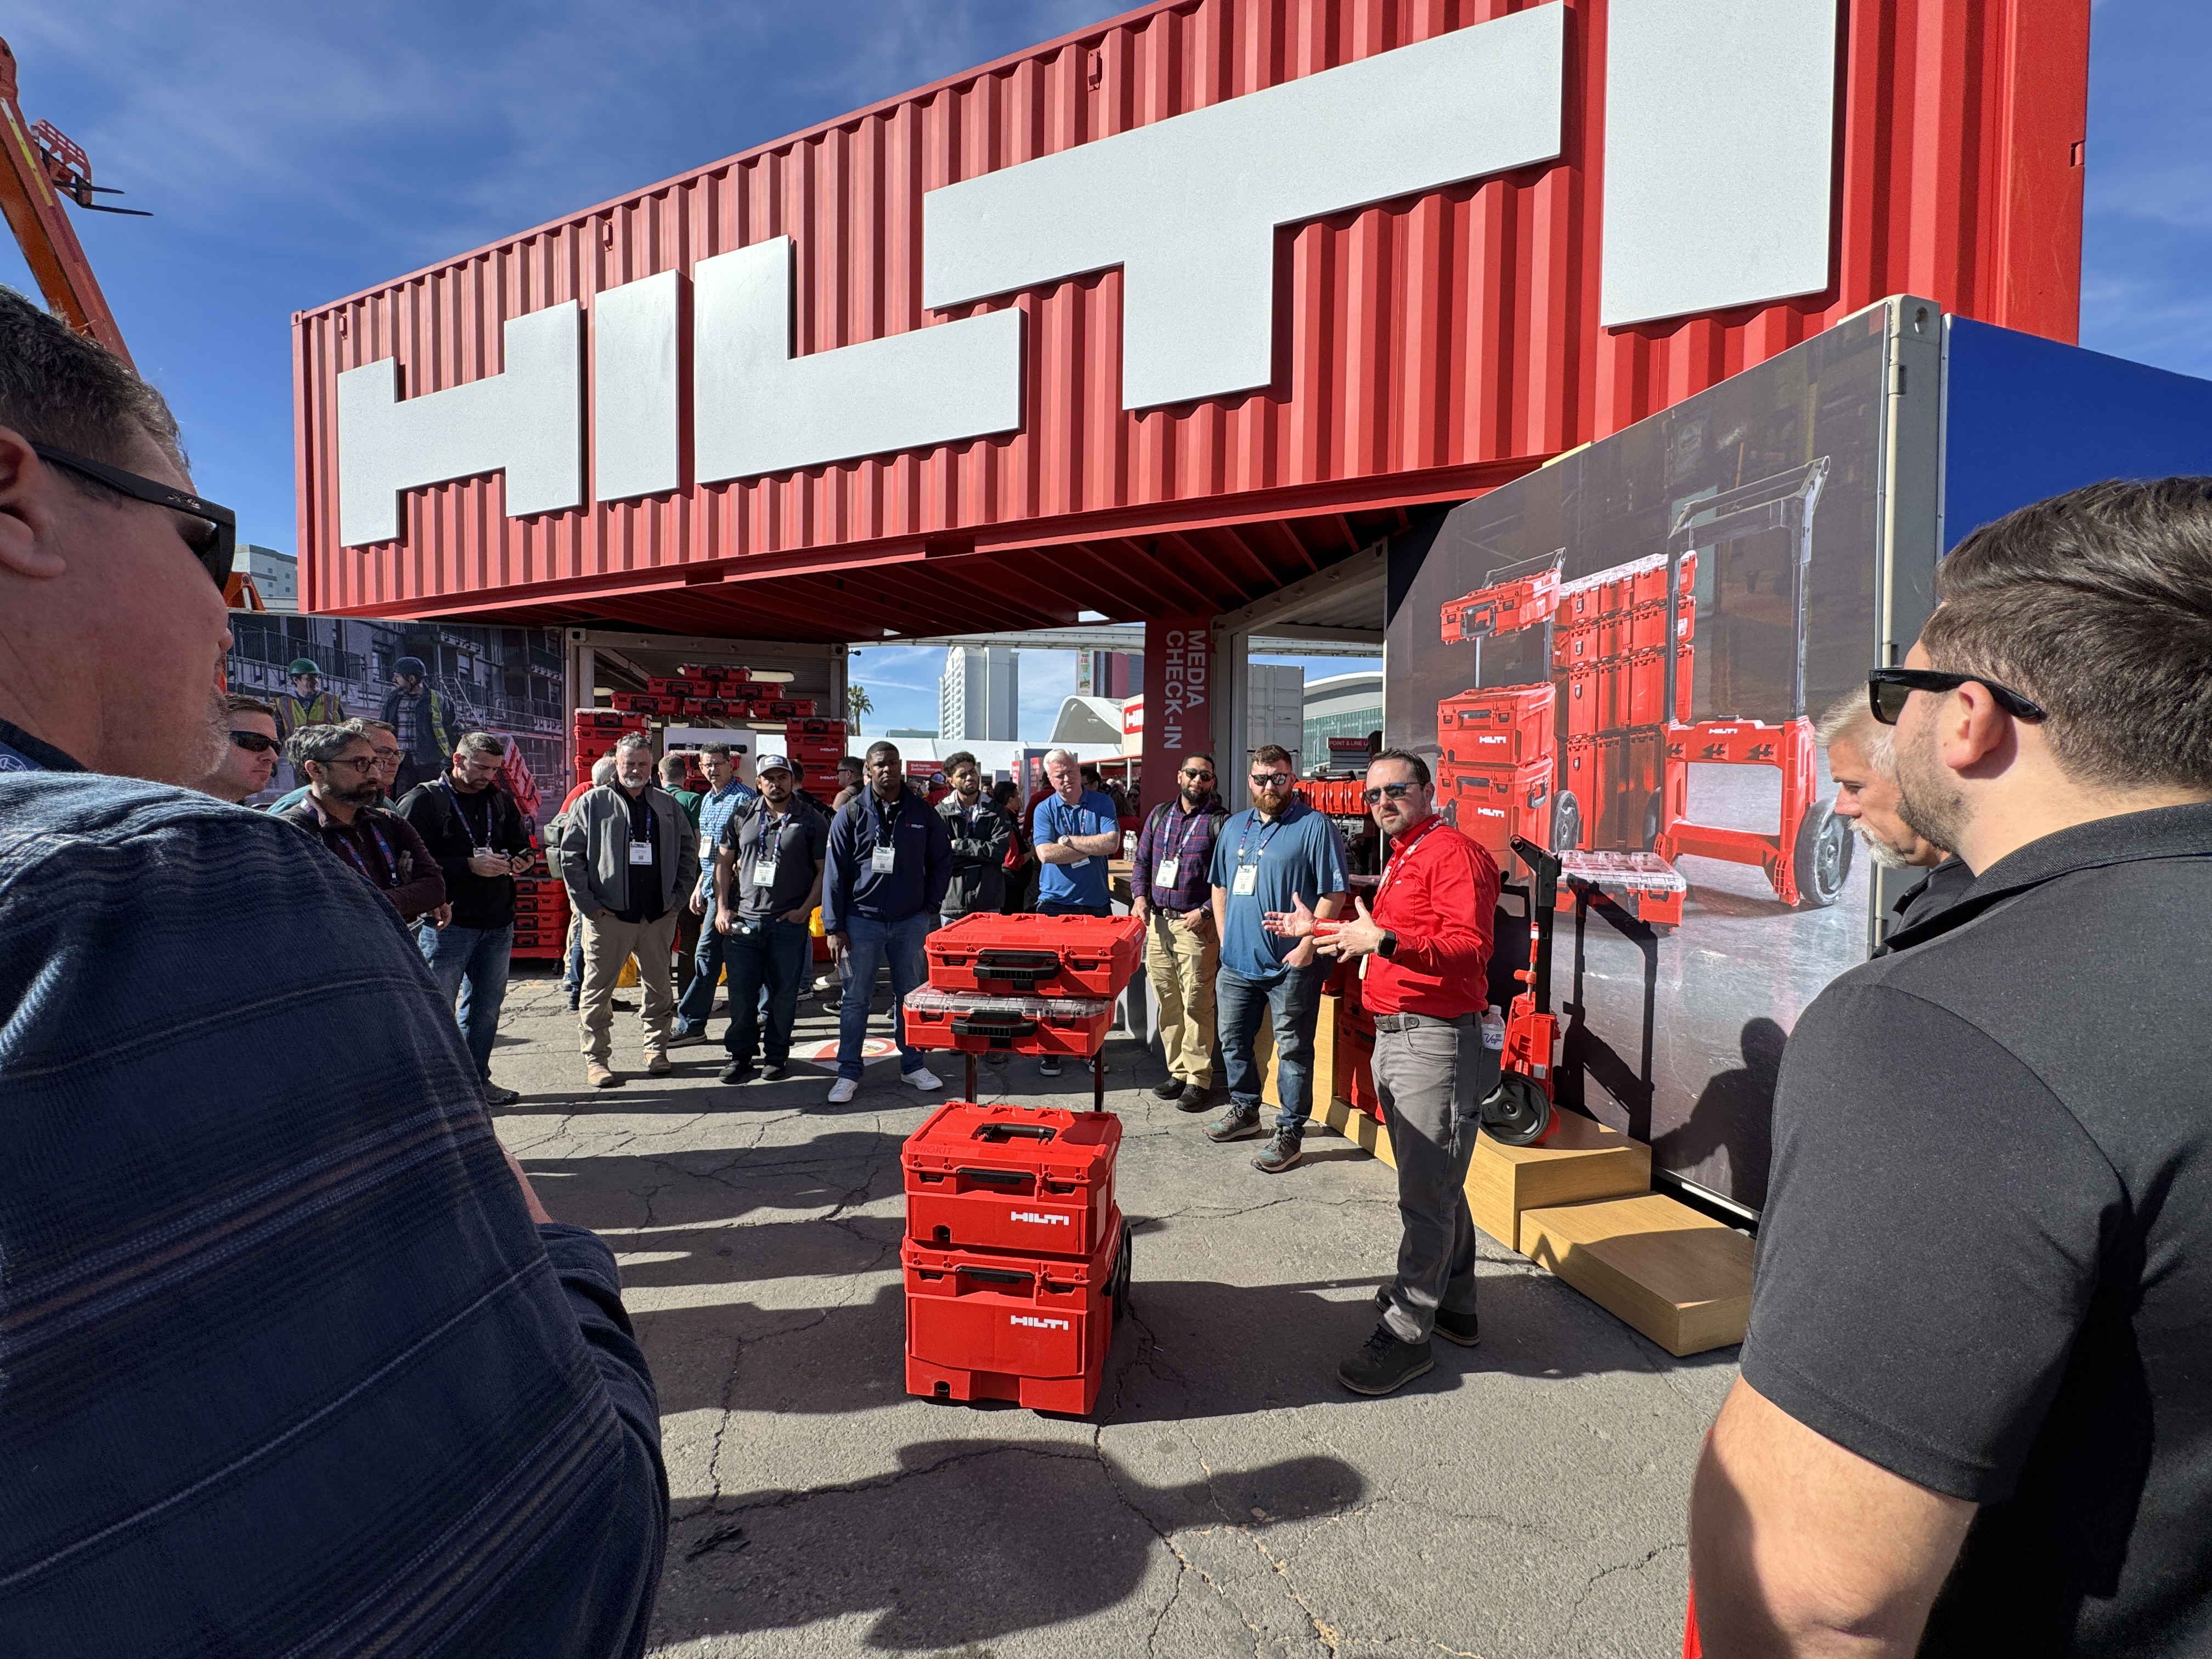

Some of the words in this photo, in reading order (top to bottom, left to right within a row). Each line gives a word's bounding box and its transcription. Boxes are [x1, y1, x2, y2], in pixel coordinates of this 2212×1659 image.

[338, 0, 1836, 547] HILTI
[1186, 630, 1206, 709] MEDIA
[1164, 630, 1184, 748] CHECK-IN
[1477, 807, 1505, 818] HILTI
[912, 1145, 954, 1155] PROKIT
[1011, 1211, 1069, 1226] HILTI
[1011, 1315, 1069, 1330] HILTI
